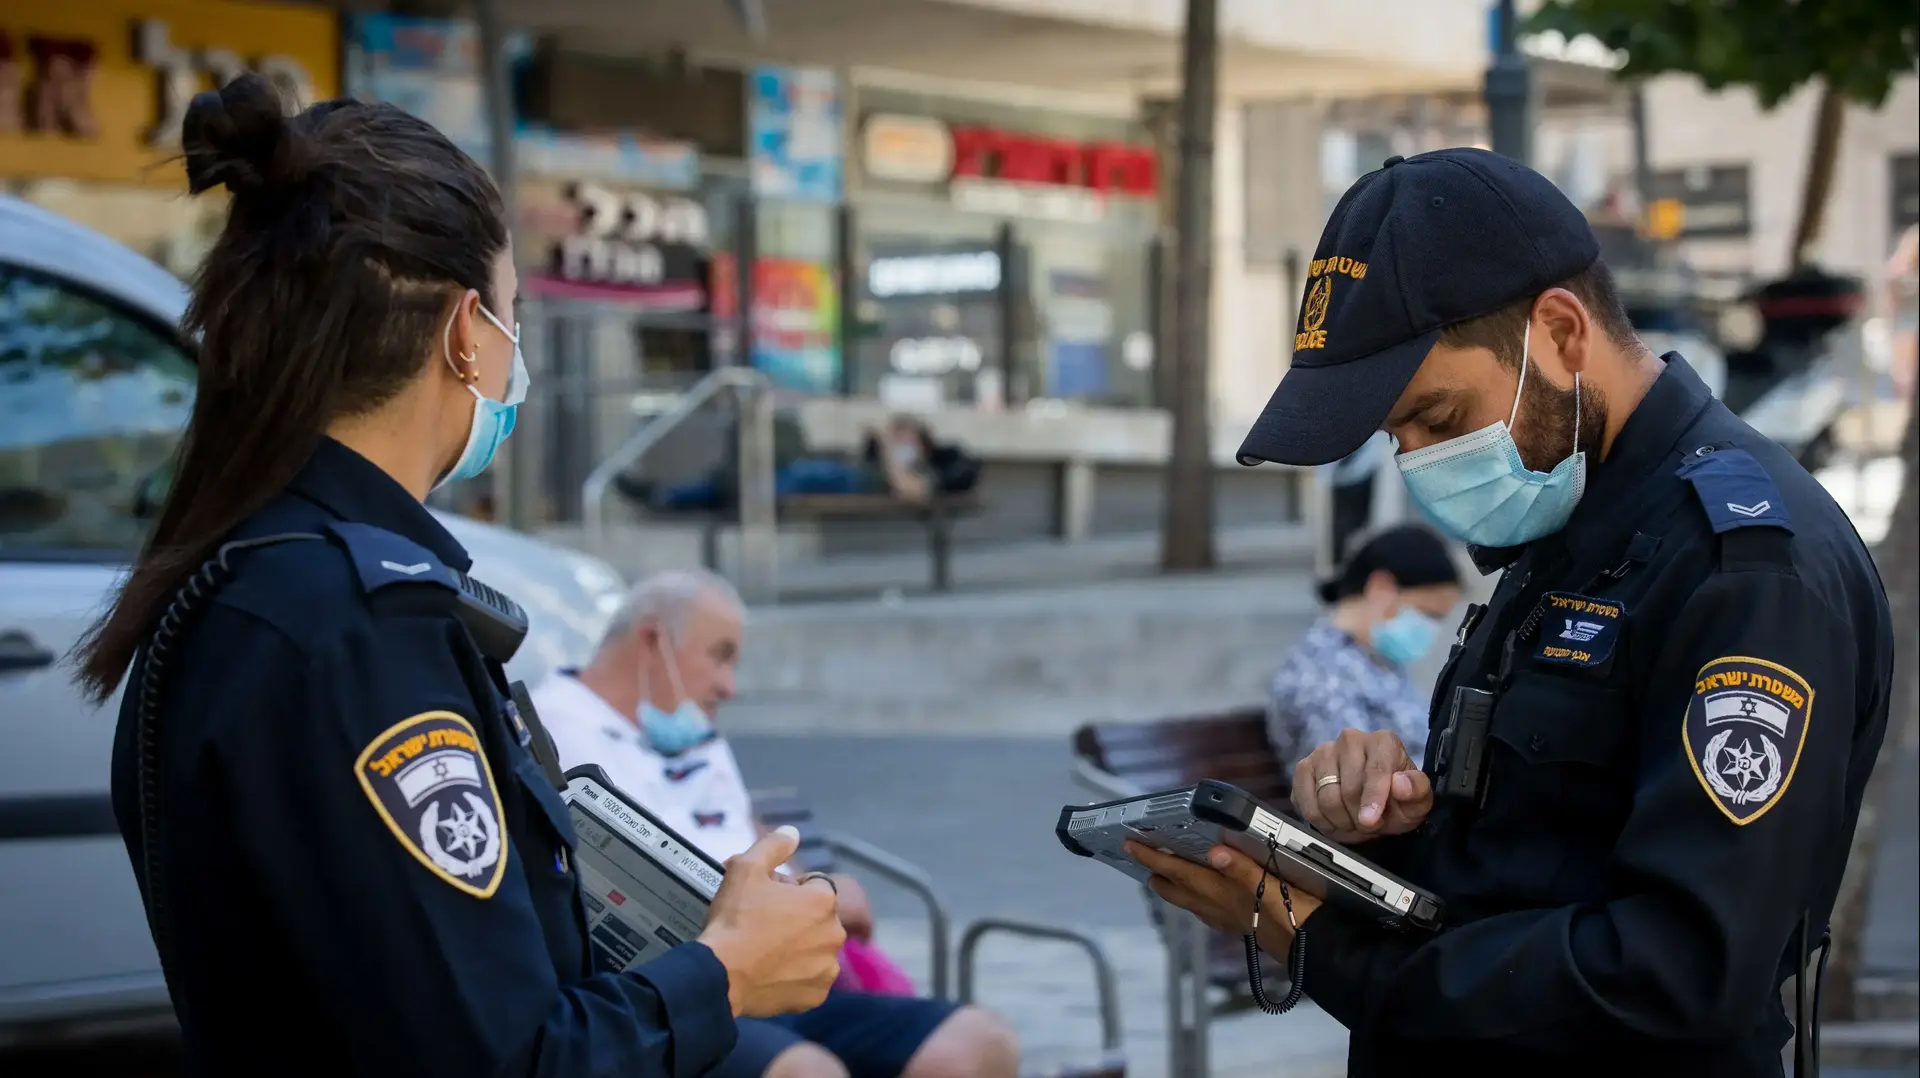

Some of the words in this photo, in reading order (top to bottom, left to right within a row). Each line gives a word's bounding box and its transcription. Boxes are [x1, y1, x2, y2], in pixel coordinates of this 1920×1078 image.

[1550, 594, 1587, 611] ישראל
[1585, 602, 1619, 618] משטרת
[1748, 673, 1805, 710] משטרת
[369, 733, 428, 777] ישראל
[601, 797, 623, 816] 15006
[619, 811, 639, 829] טאבלט
